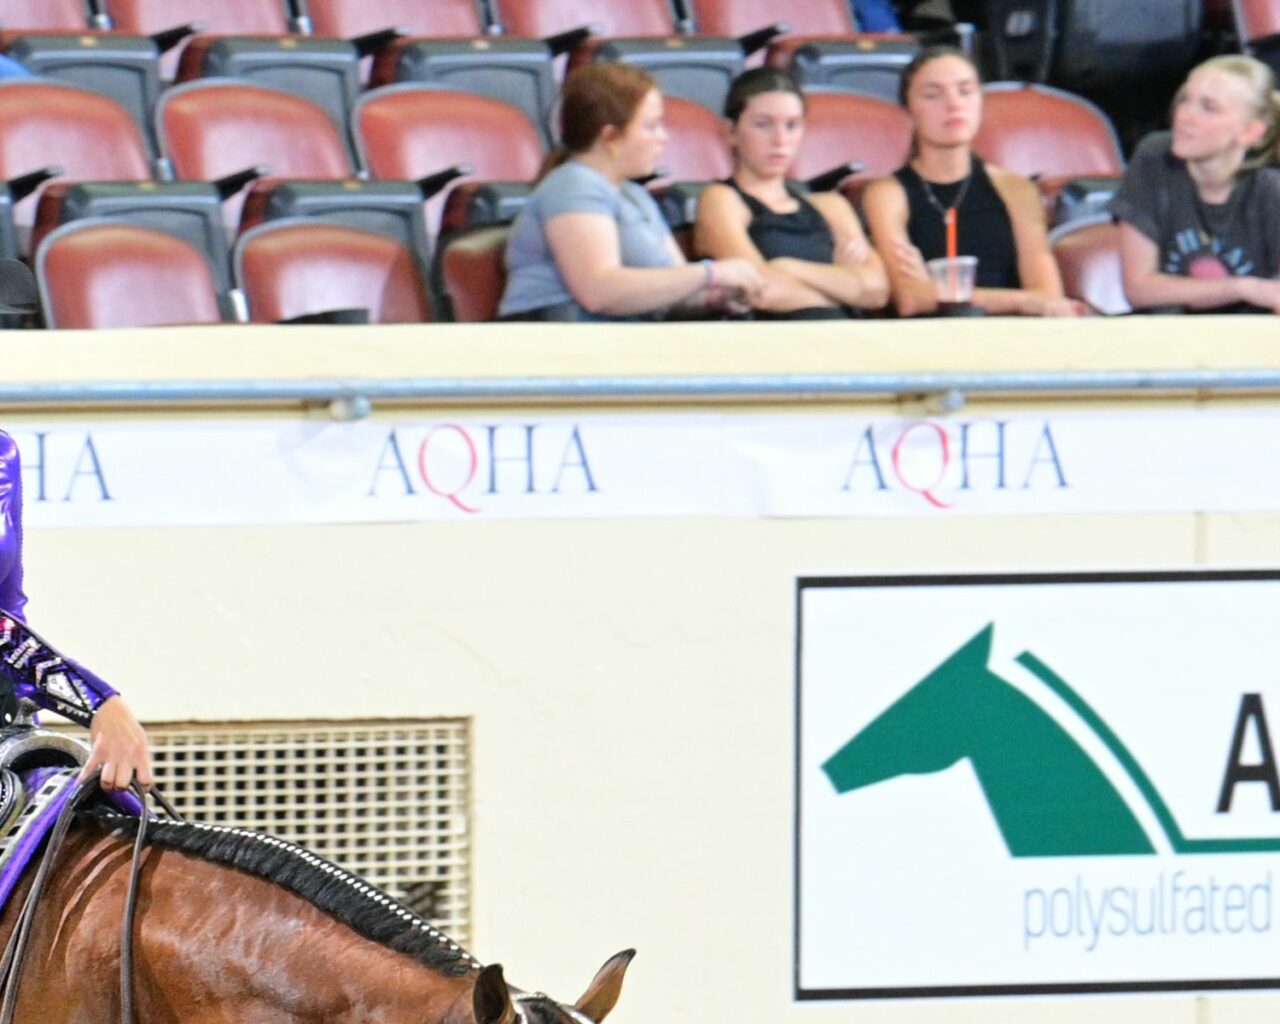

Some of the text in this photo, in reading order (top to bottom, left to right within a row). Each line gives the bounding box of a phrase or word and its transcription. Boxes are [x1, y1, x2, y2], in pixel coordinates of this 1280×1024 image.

[369, 424, 599, 513] AQHA
[841, 421, 1070, 508] AQHA
[1023, 871, 1272, 952] polysulfated
